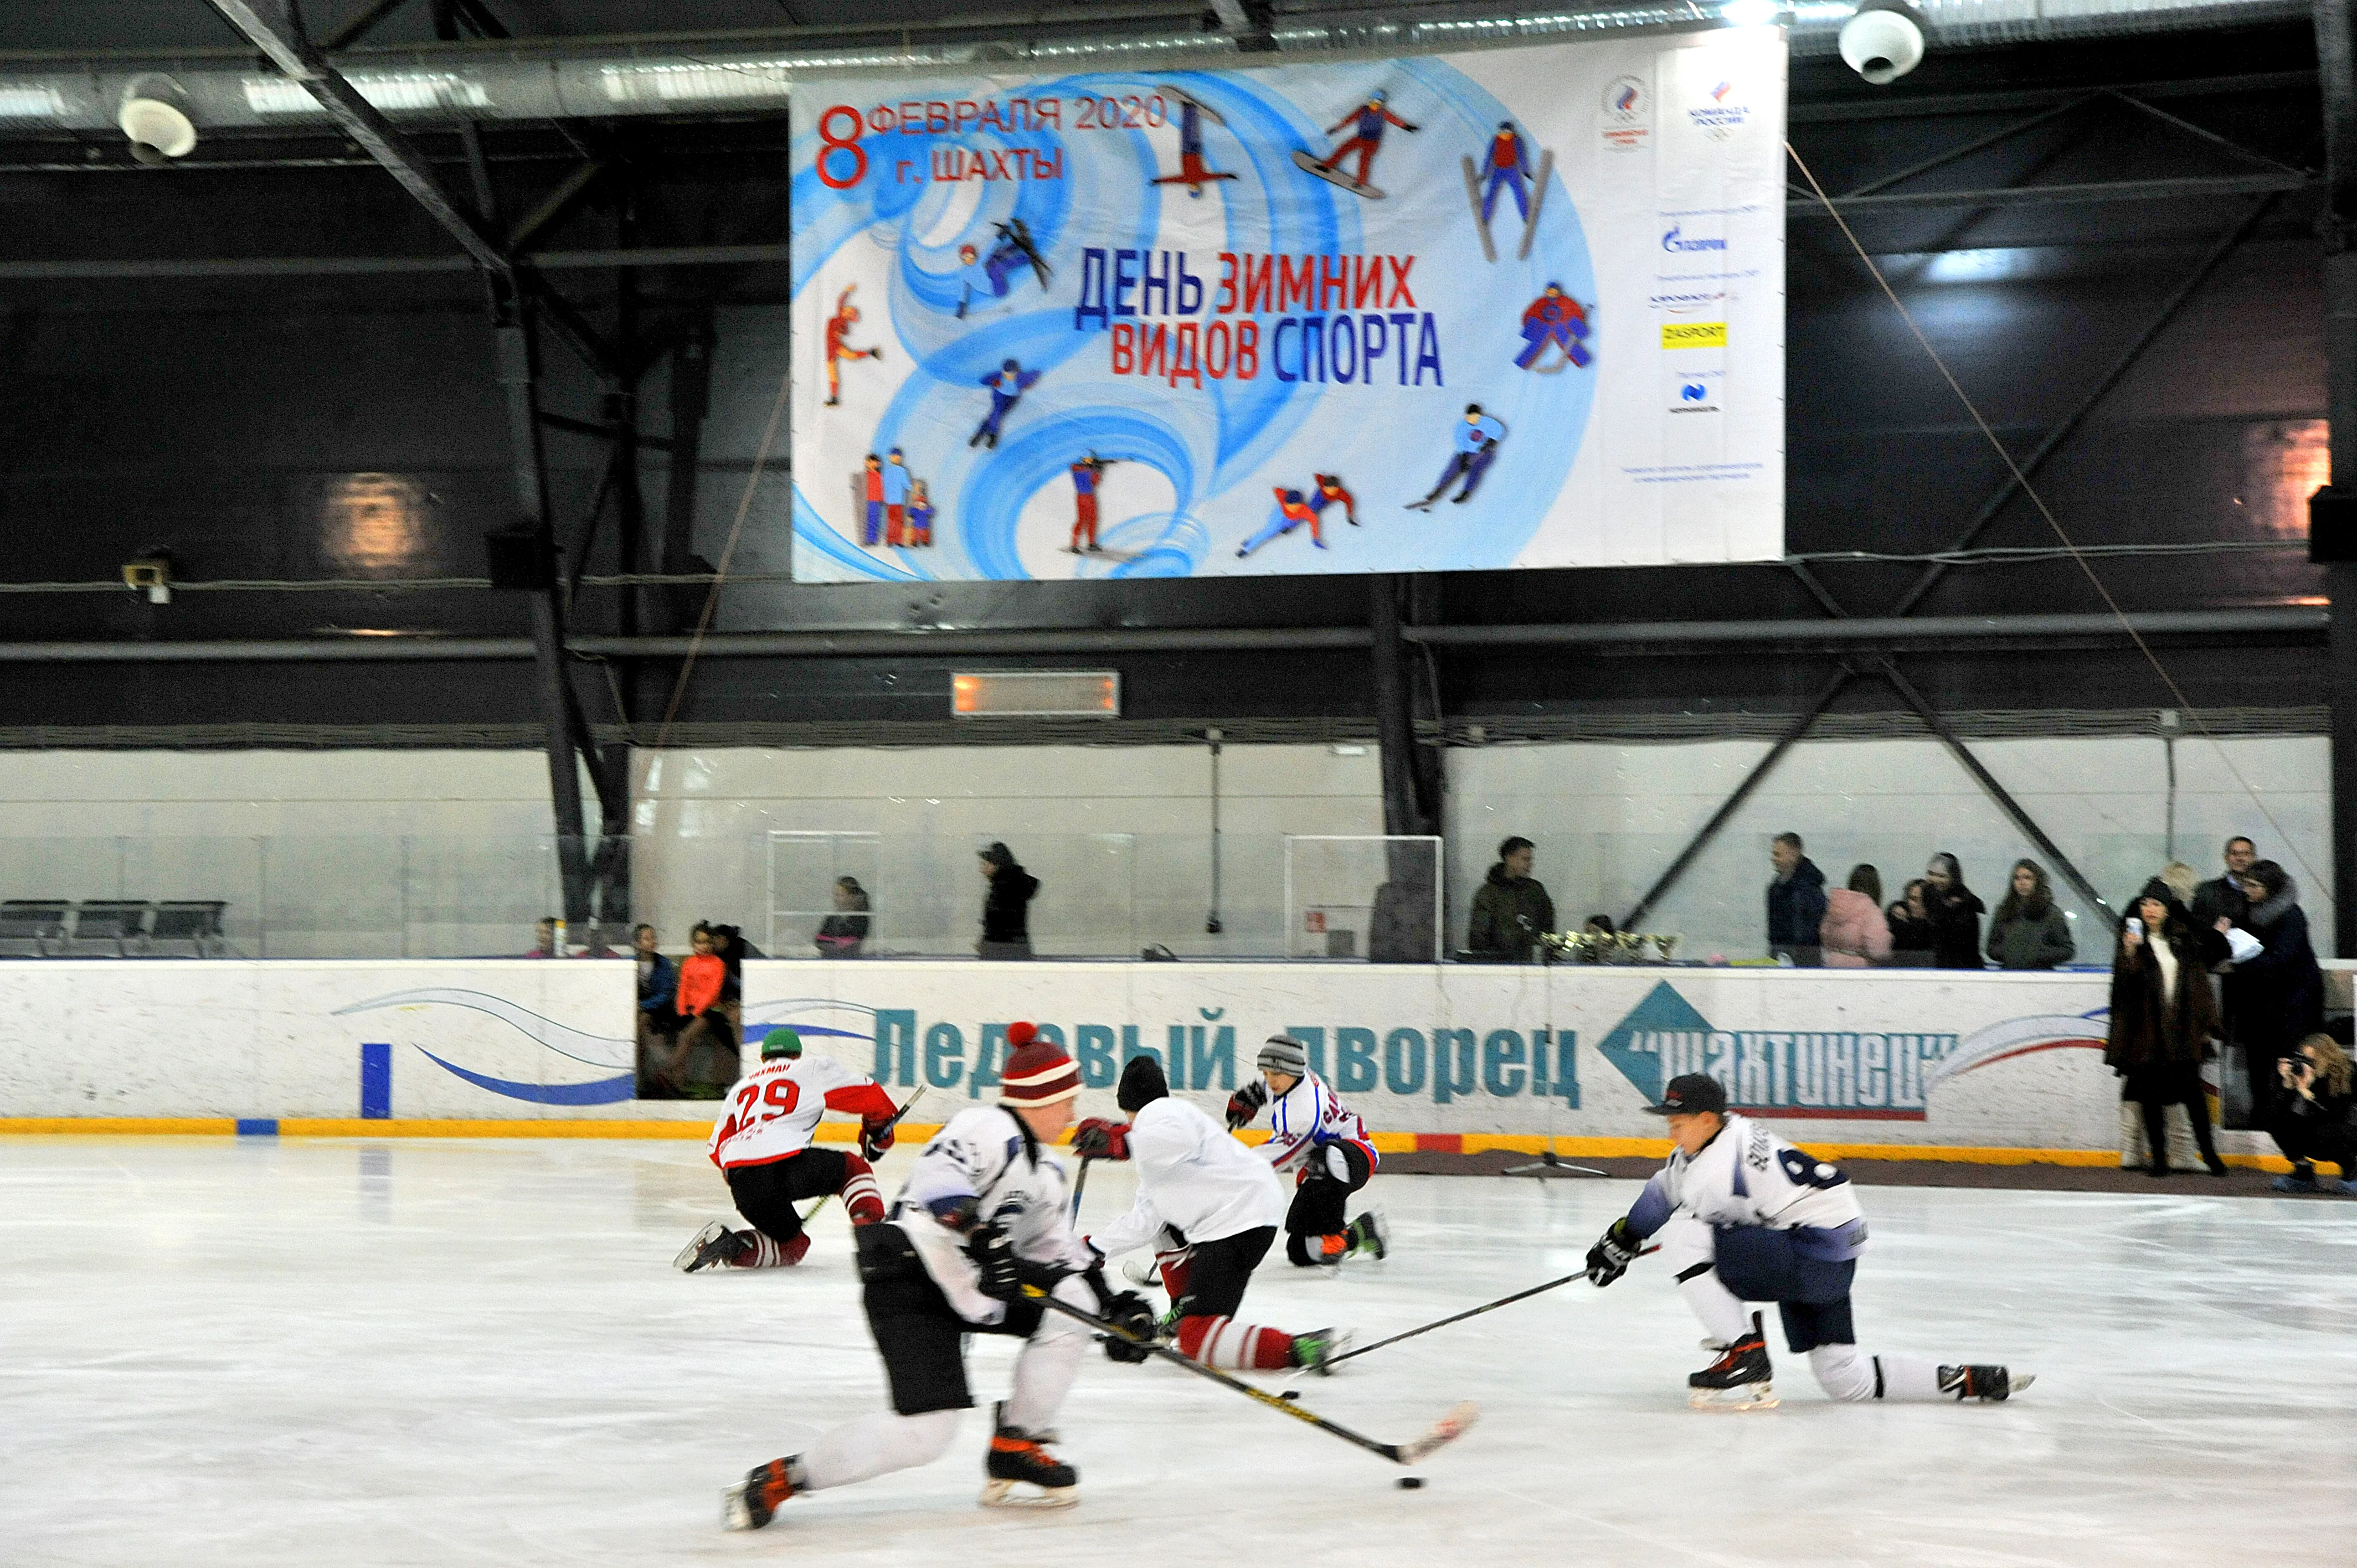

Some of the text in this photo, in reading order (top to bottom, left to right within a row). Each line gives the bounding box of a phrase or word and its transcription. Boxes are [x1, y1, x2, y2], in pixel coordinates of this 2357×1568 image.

[816, 95, 1166, 189] 8 ФЕВРАЛЯ 2020
[932, 148, 1063, 182] ШАХТЫ
[1074, 247, 1418, 332] ДЕНЬ ЗИМНИХ
[1111, 311, 1445, 390] ВИДОВ СПОРТА
[872, 1008, 1236, 1100] Ледвый
[736, 1079, 800, 1132] 29
